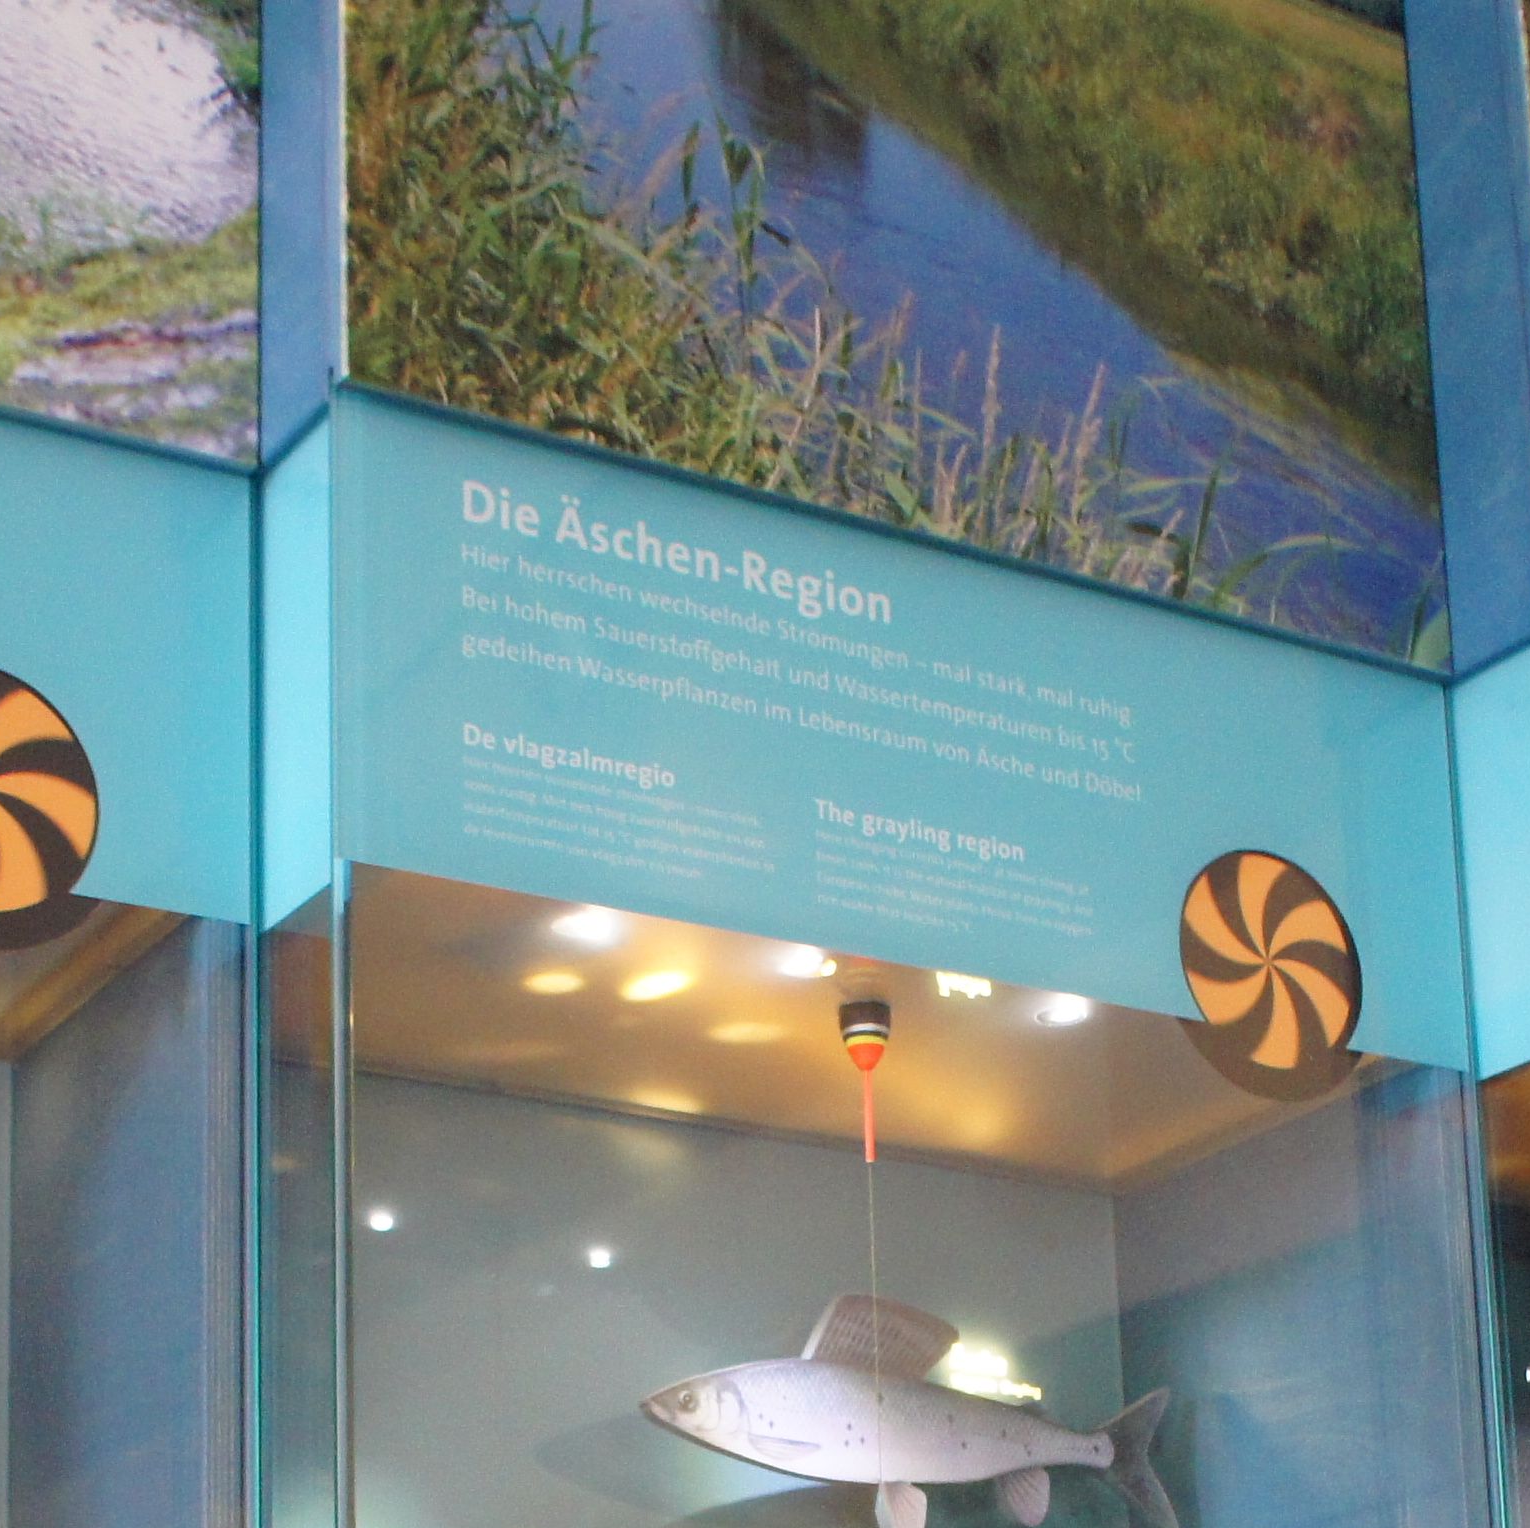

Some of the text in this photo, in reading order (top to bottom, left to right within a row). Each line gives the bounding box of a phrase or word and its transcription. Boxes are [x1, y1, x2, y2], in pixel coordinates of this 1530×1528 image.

[463, 480, 891, 624] Die Äschen-Region
[463, 722, 675, 789] De vlagzalmregio
[815, 798, 1025, 862] The grayling region
